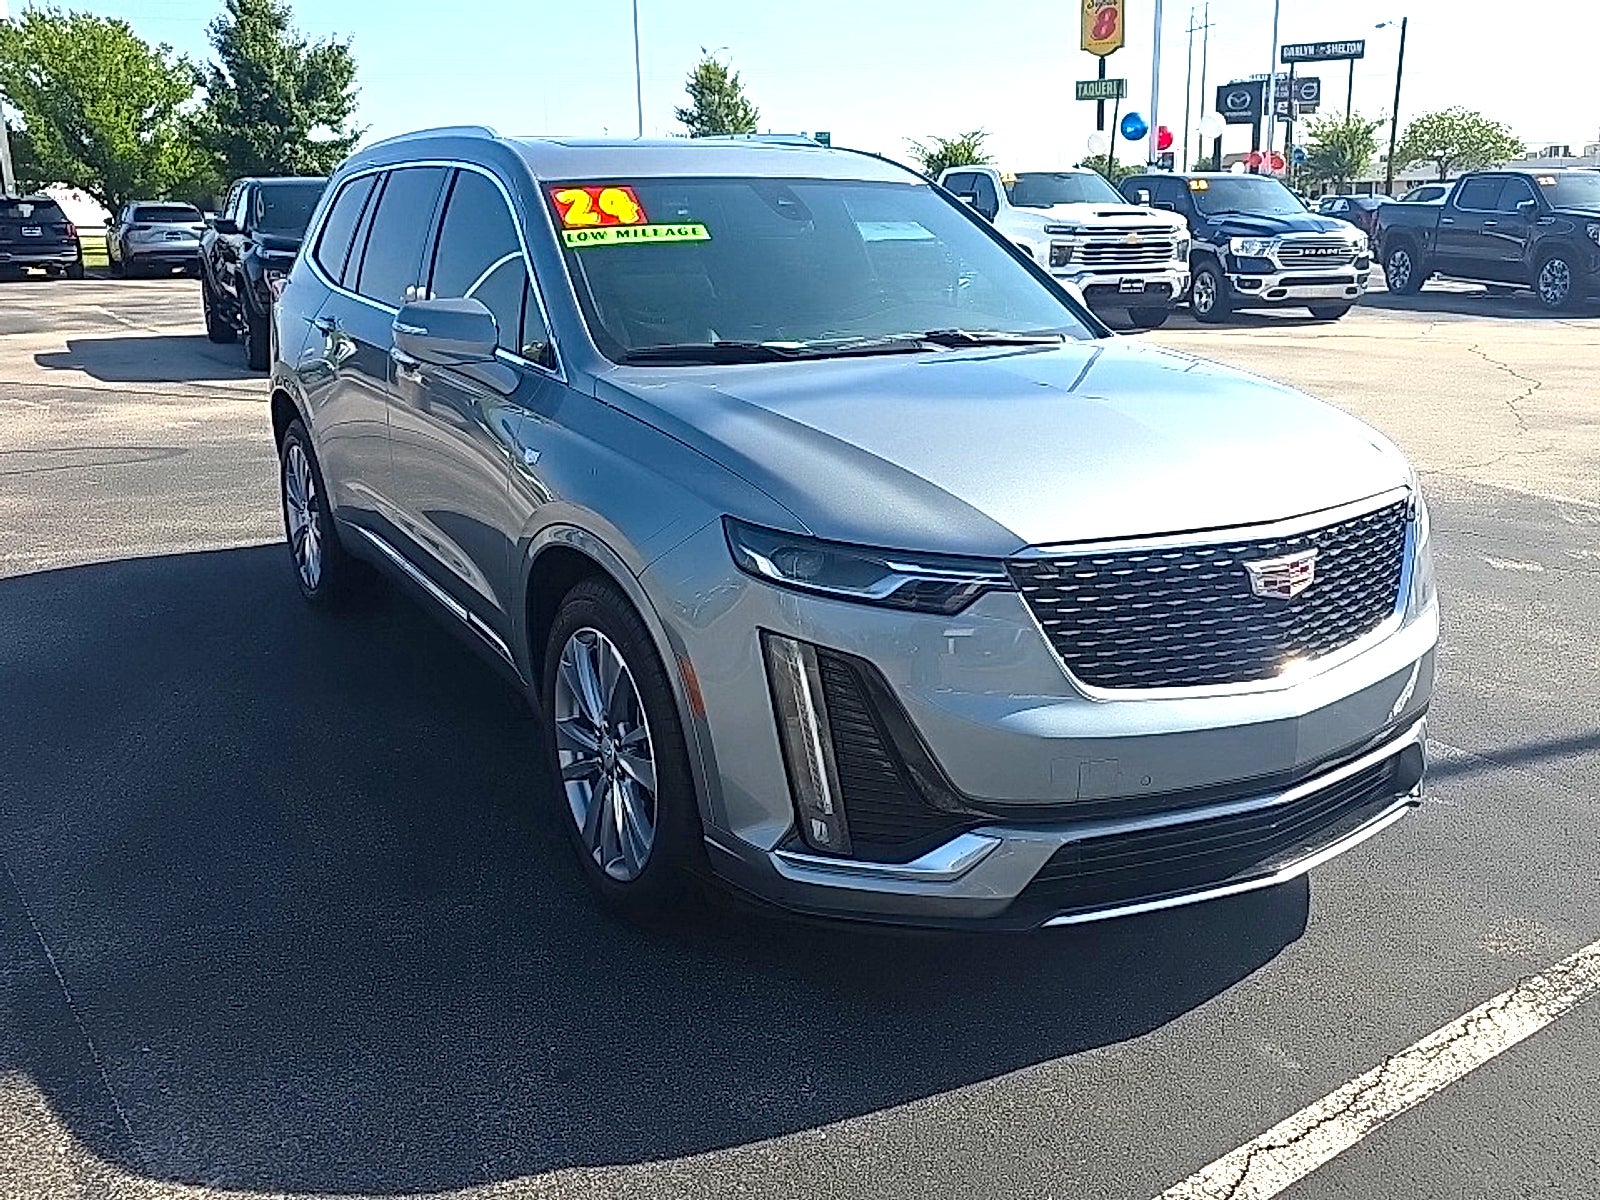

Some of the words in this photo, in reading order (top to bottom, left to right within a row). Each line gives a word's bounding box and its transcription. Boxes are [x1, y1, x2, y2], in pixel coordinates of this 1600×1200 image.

[1090, 7, 1118, 40] 8
[1325, 42, 1363, 54] SHELTON
[554, 188, 640, 225] 24
[566, 230, 608, 243] LOW
[615, 226, 701, 239] MILEAGE
